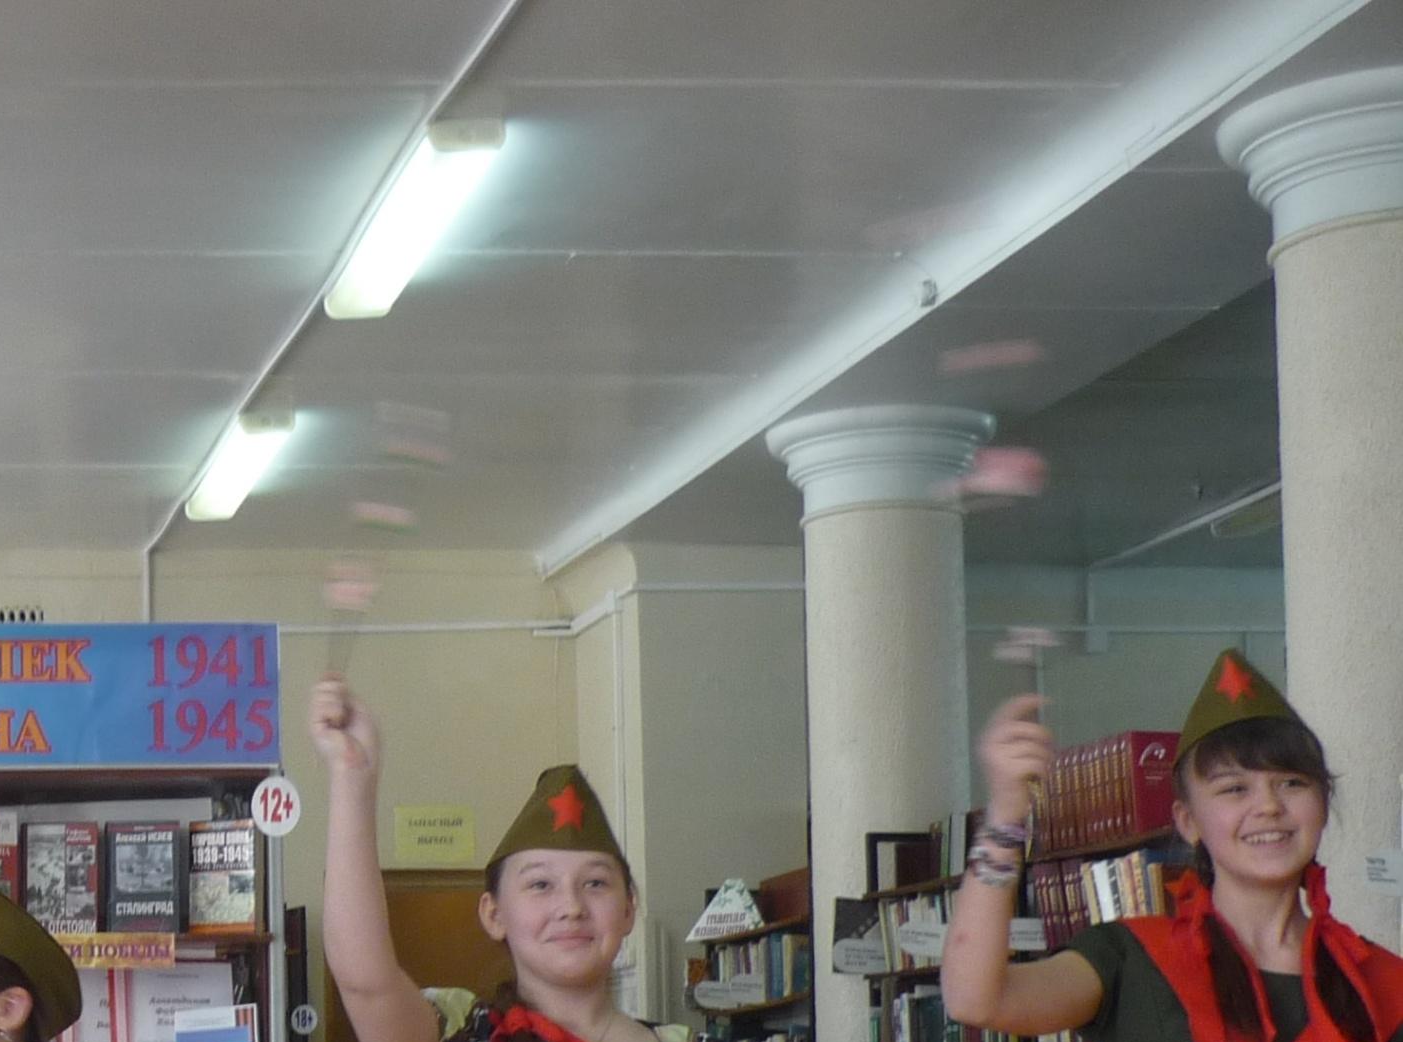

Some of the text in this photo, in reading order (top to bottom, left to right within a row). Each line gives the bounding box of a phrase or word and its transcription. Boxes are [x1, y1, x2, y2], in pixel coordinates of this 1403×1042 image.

[147, 634, 274, 688] 1941
[147, 699, 275, 753] 1945
[260, 787, 294, 823] 12+
[116, 900, 174, 916] СТАЛИНГРАД
[90, 943, 171, 961] ПОБЕДЫ
[294, 1009, 313, 1029] 18+
